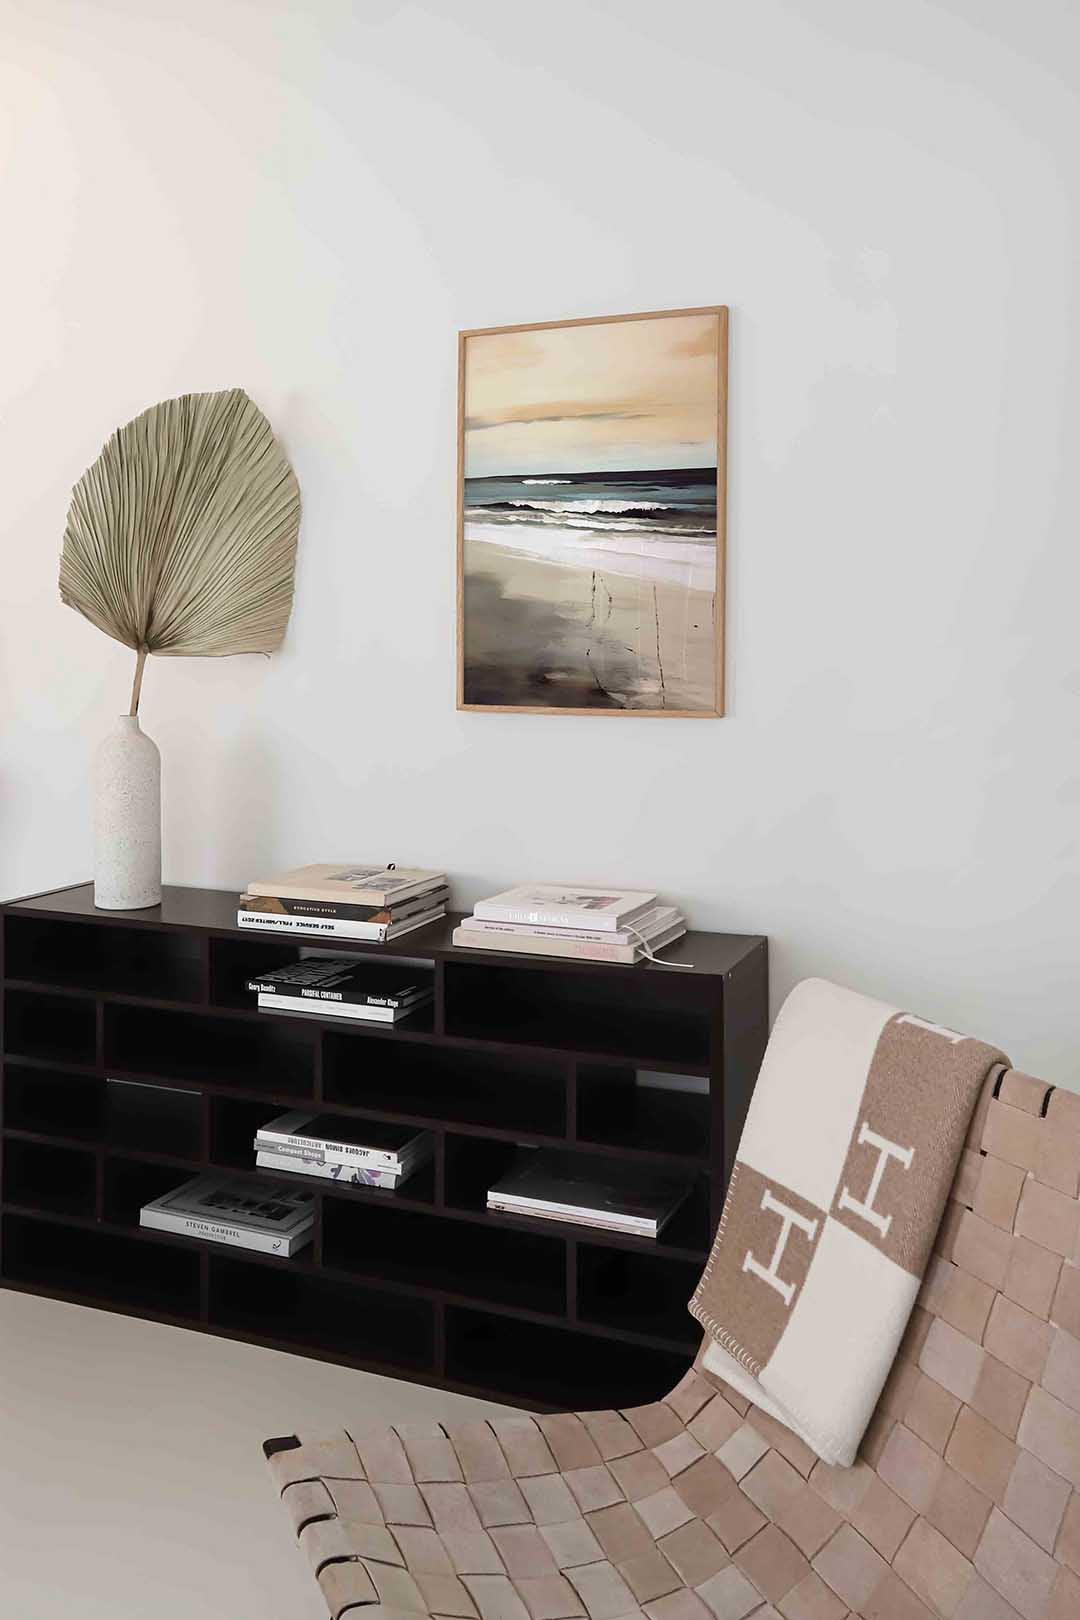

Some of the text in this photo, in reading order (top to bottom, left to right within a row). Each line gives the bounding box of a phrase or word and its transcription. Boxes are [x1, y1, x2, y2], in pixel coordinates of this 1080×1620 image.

[295, 921, 319, 929] SERVICE
[325, 1143, 343, 1153] SIMON
[345, 1147, 370, 1157] JACQUES
[837, 1121, 915, 1239] H
[186, 1220, 209, 1231] STEVEN
[742, 1188, 819, 1307] H
